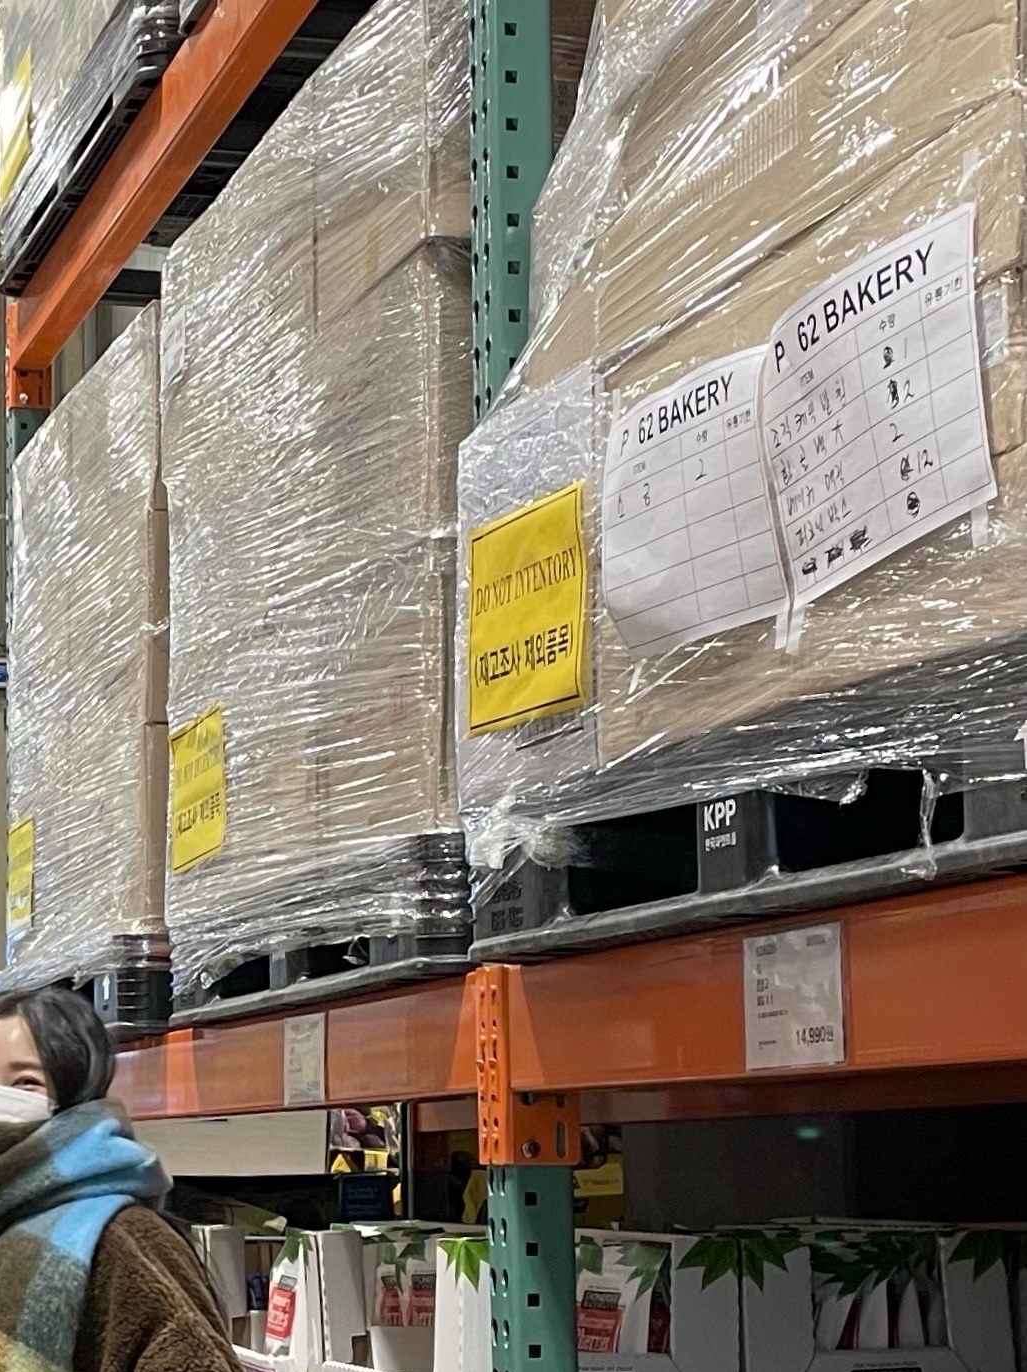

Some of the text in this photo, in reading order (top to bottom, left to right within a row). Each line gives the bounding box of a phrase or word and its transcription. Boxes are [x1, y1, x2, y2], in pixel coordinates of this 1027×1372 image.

[774, 241, 934, 373] P 62 BAKERY
[620, 371, 734, 457] P 62 BAKERY
[889, 423, 904, 443] 2
[695, 458, 708, 481] 2
[475, 584, 490, 616] DO
[493, 574, 512, 609] NOT
[704, 799, 736, 832] KPP
